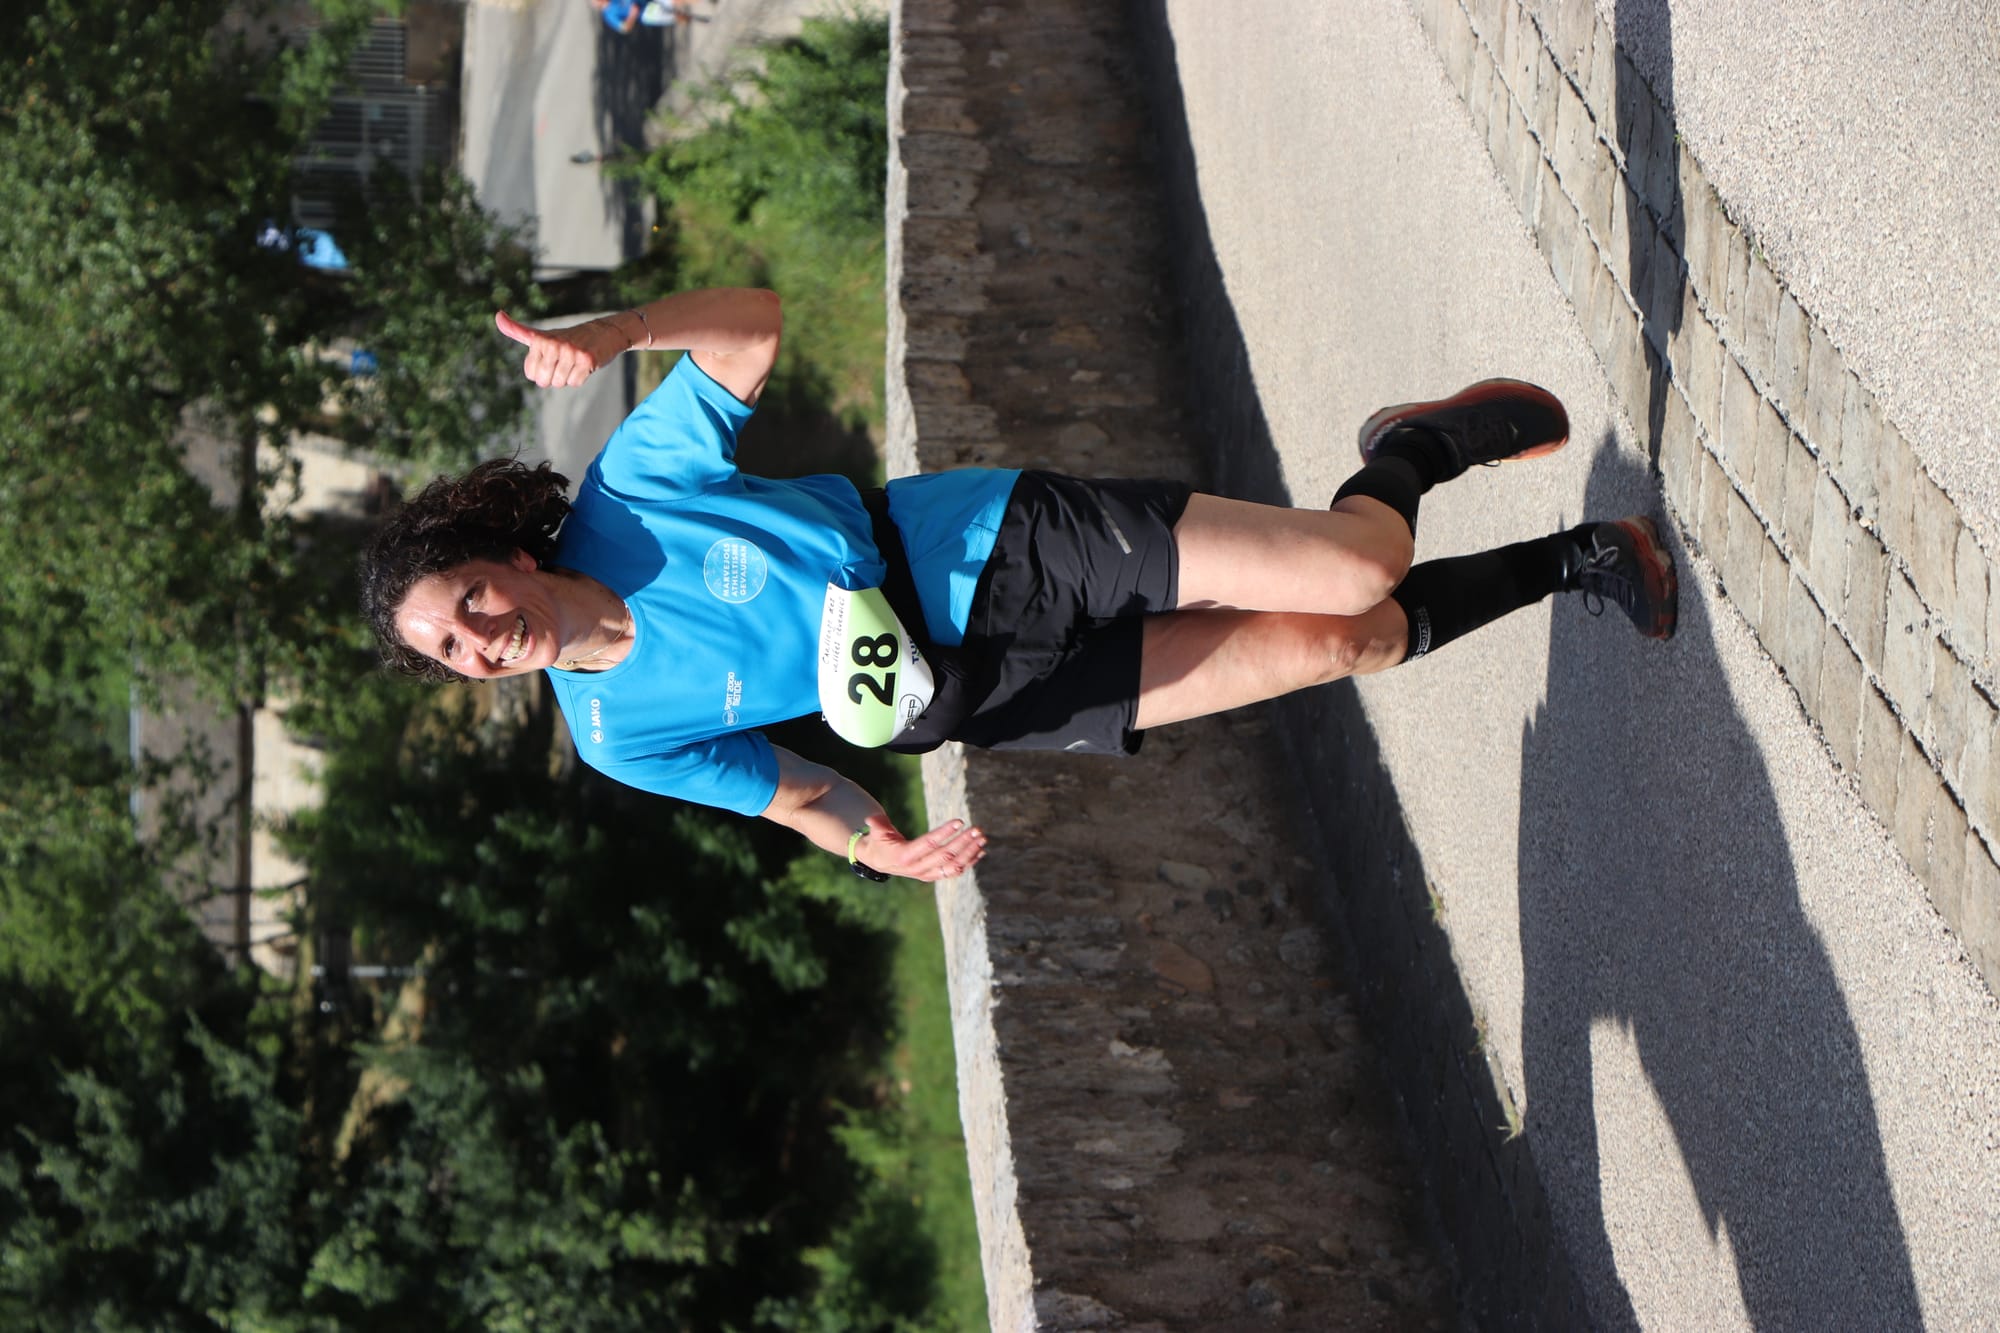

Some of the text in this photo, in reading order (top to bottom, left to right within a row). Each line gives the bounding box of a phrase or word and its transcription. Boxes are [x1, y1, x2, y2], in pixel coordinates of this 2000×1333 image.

[726, 671, 735, 692] 2000
[847, 632, 899, 707] 28
[590, 698, 601, 728] JAKO
